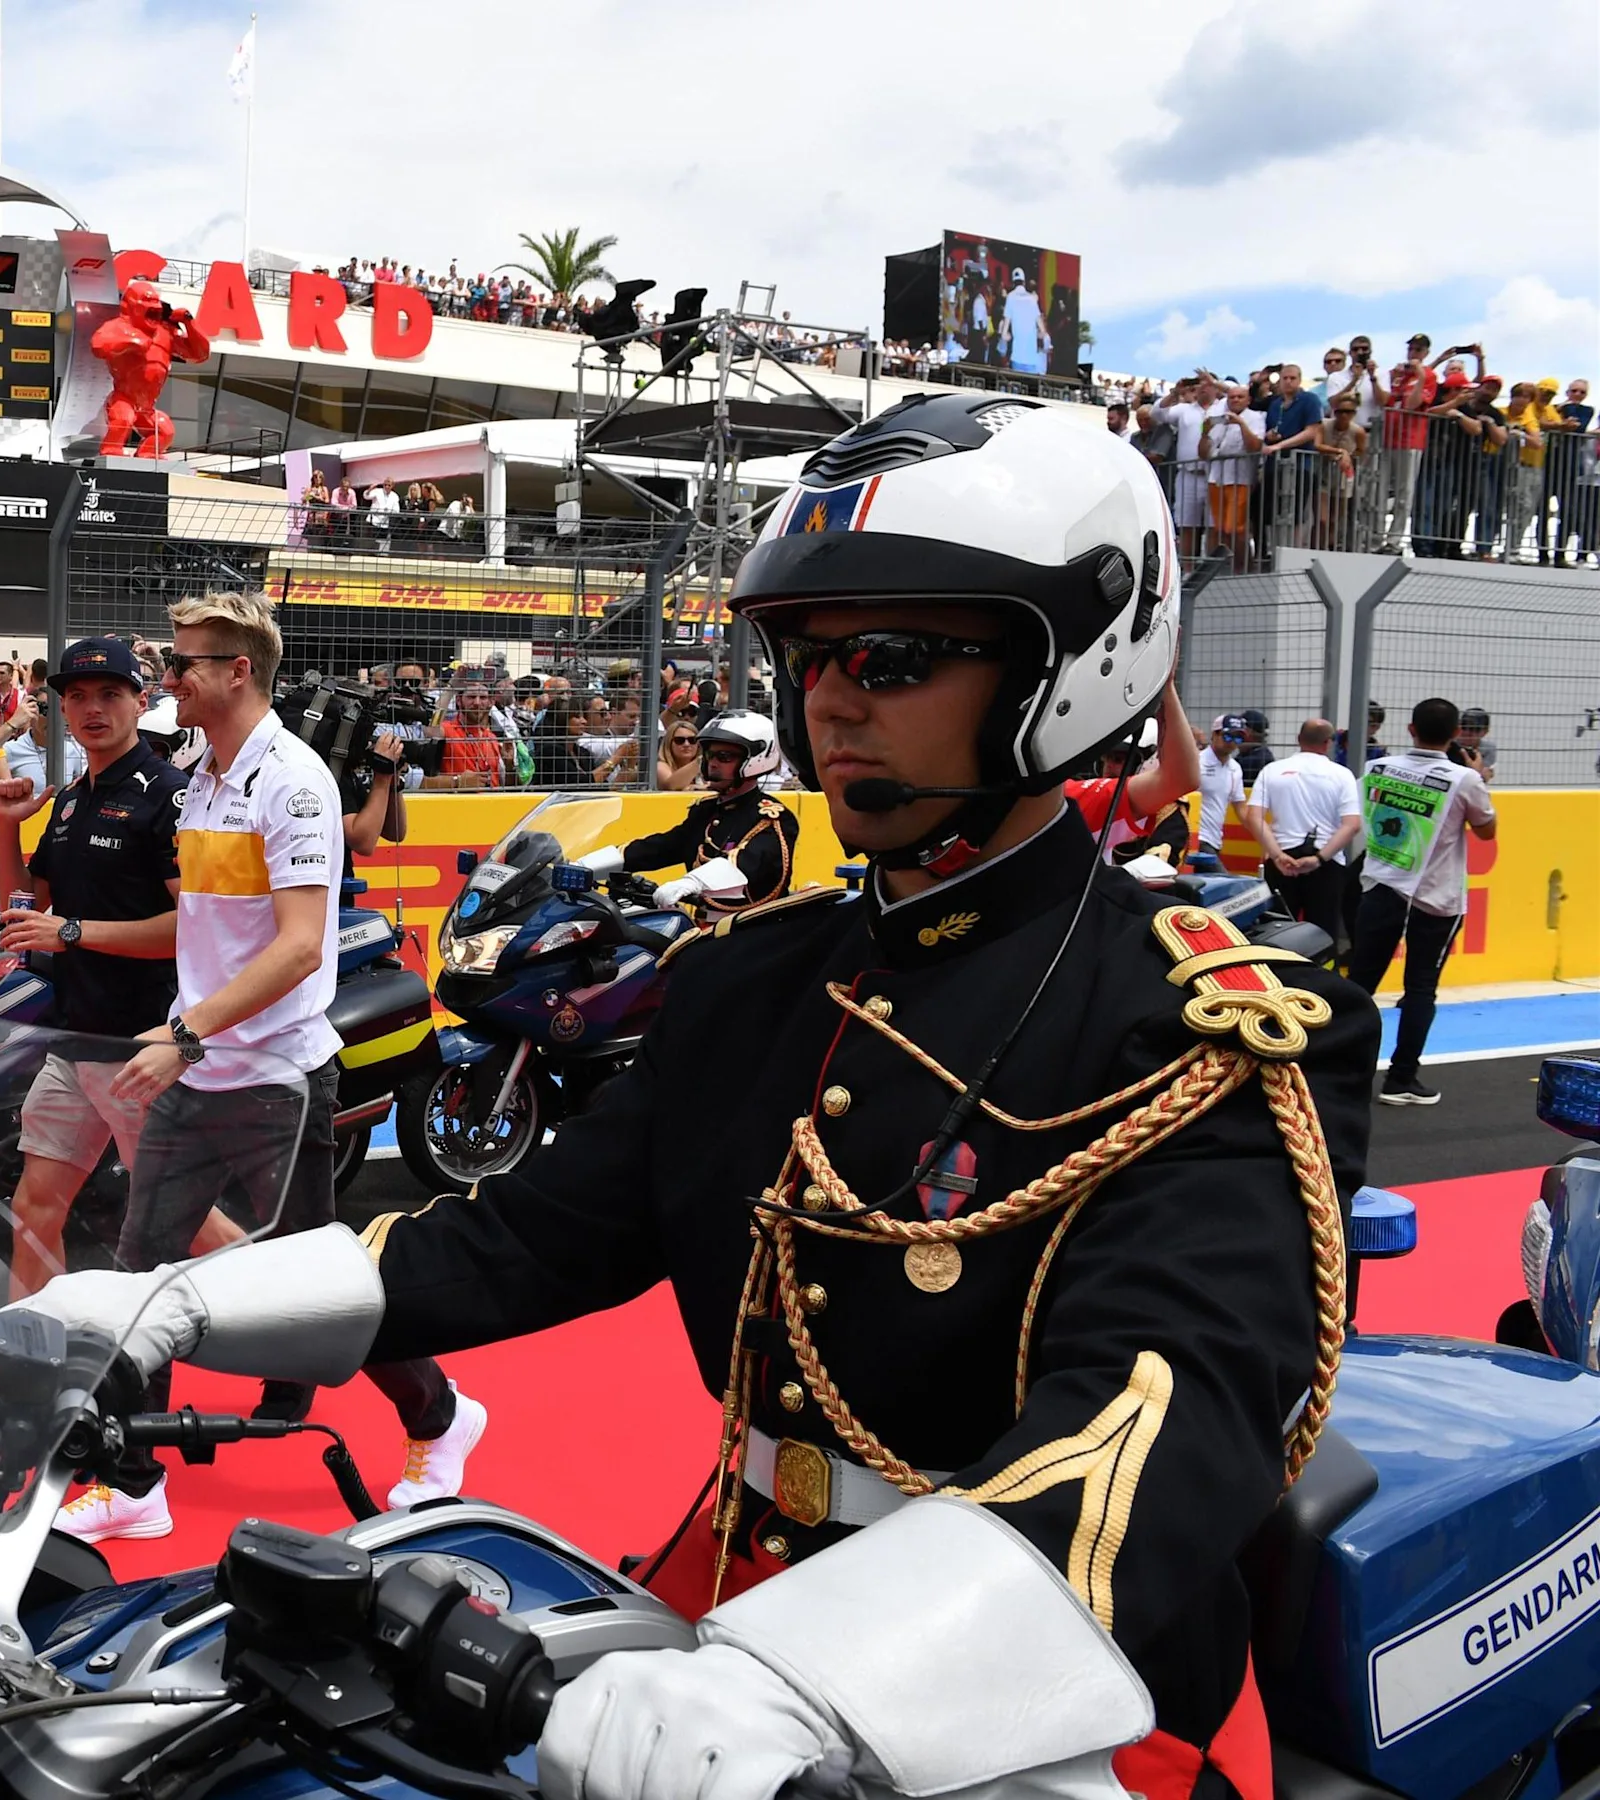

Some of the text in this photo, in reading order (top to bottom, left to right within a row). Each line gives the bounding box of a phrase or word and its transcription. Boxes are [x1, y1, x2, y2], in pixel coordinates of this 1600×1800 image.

[14, 352, 47, 362] PIRELLI
[267, 577, 343, 600] DHL
[378, 583, 449, 605] DHL
[483, 590, 548, 610] DHL
[291, 798, 319, 807] Estrella
[294, 805, 319, 813] Galicia
[1385, 793, 1427, 813] PHOTO
[89, 835, 111, 848] Mobil
